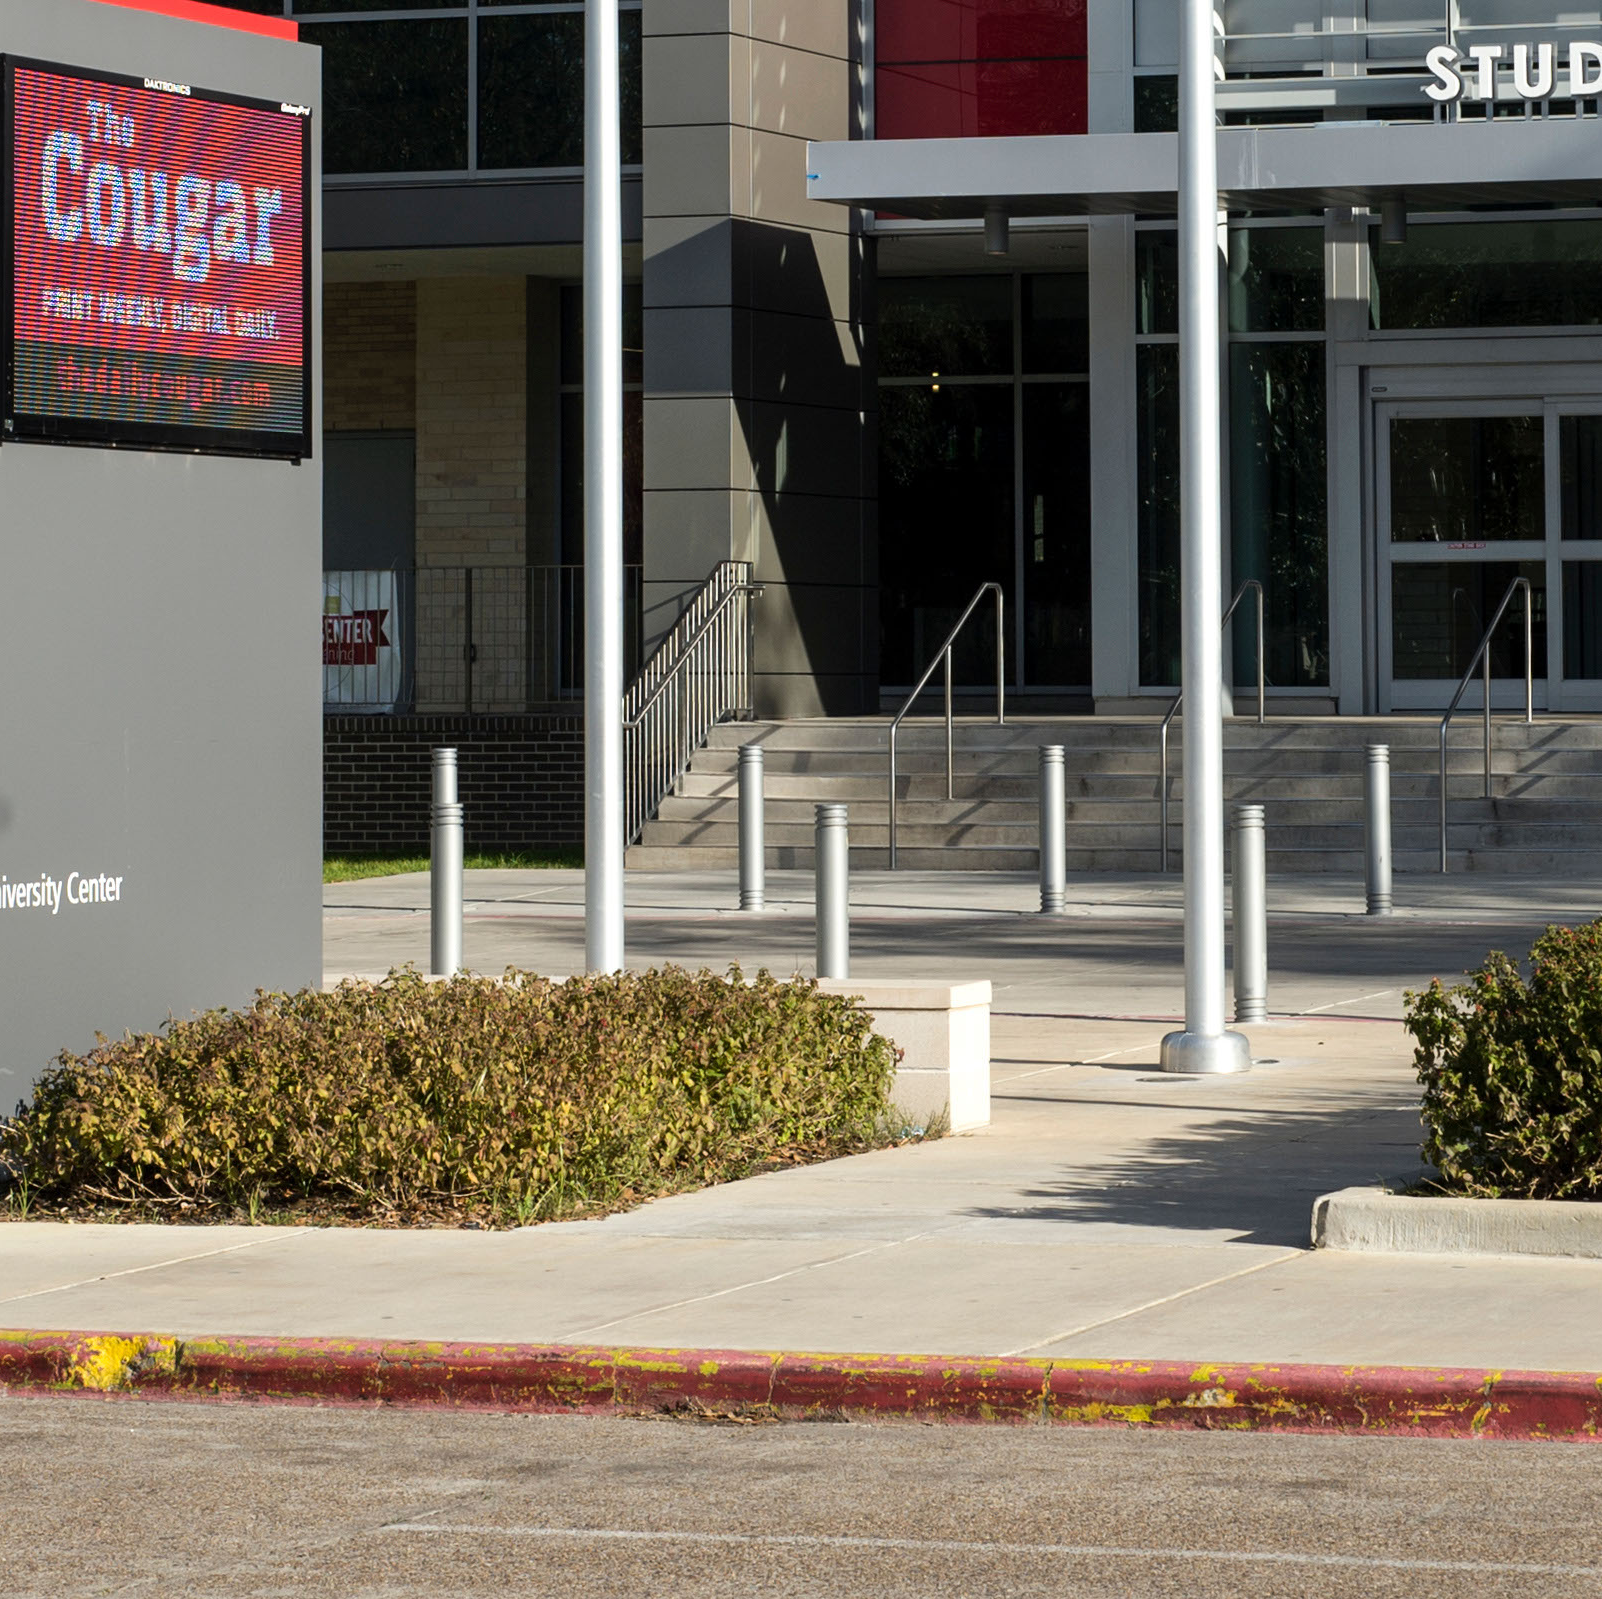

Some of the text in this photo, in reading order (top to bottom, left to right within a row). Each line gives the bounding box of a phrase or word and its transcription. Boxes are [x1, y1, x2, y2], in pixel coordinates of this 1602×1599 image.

[144, 77, 191, 96] DAKTRONICS
[87, 99, 135, 148] The
[41, 130, 283, 282] Cougar
[42, 286, 93, 320] PRINT
[171, 300, 230, 335] DIGITAL
[67, 871, 123, 905] Center
